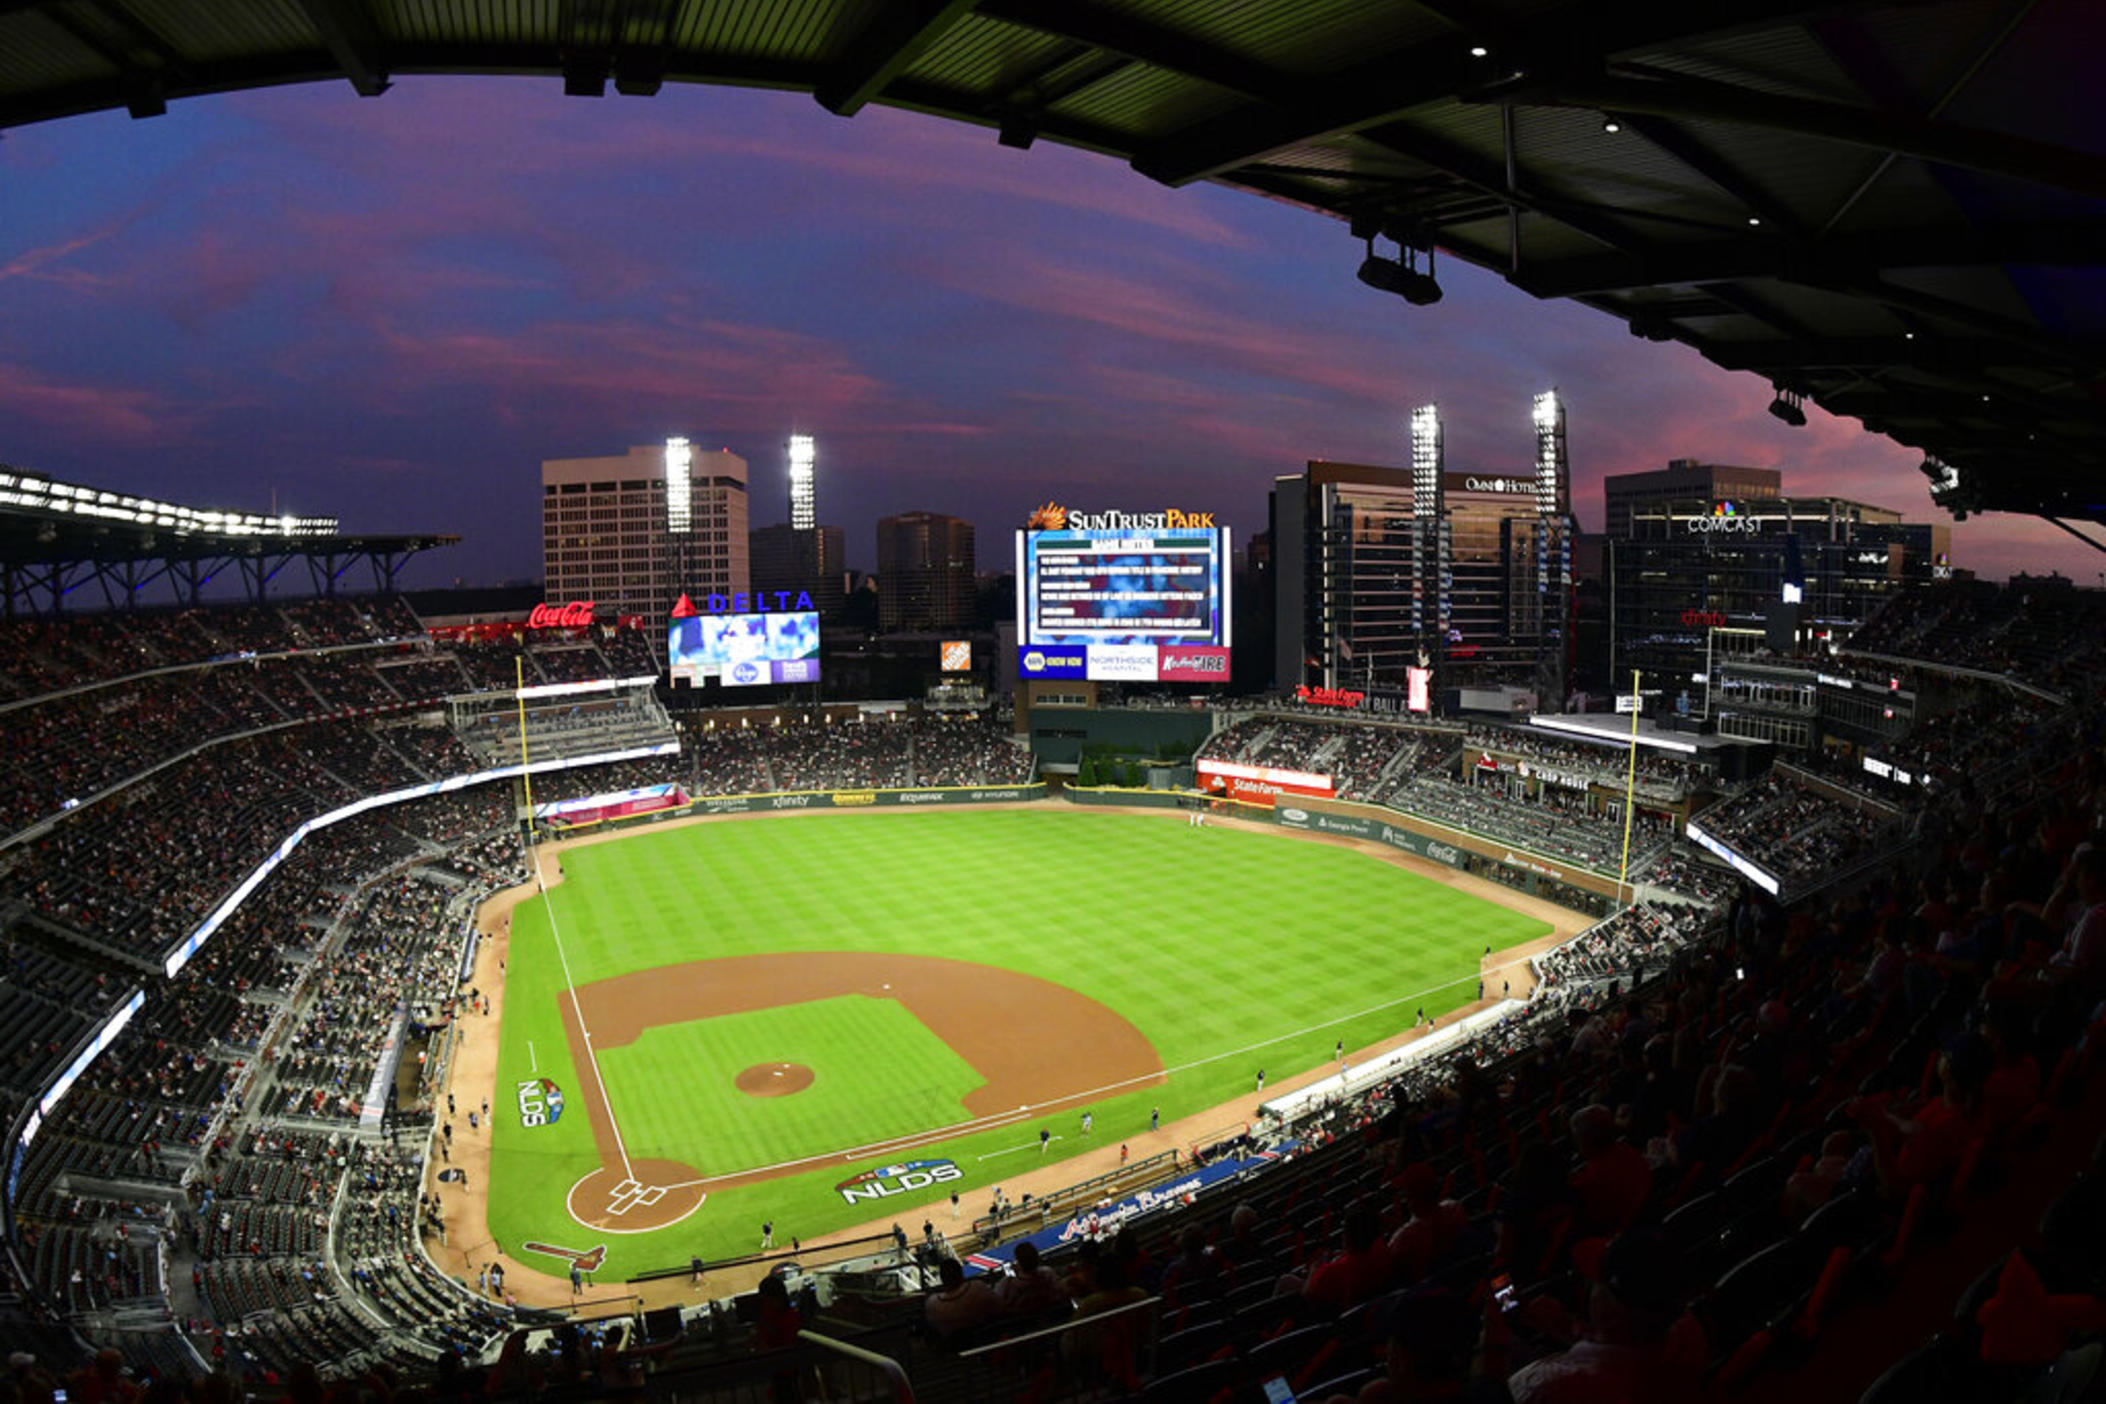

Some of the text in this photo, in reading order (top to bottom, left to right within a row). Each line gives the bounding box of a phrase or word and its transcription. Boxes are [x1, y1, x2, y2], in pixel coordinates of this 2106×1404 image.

[1687, 517, 1762, 534] COMCAST
[707, 589, 815, 613] DELTA
[1679, 607, 1728, 628] xfinity
[1089, 655, 1153, 665] NORTHSIDE
[1192, 656, 1225, 672] TIRE
[772, 795, 808, 808] xfinity
[900, 792, 943, 803] EQUIFAX
[518, 1080, 546, 1127] NLDS
[842, 1164, 963, 1204] NLDS
